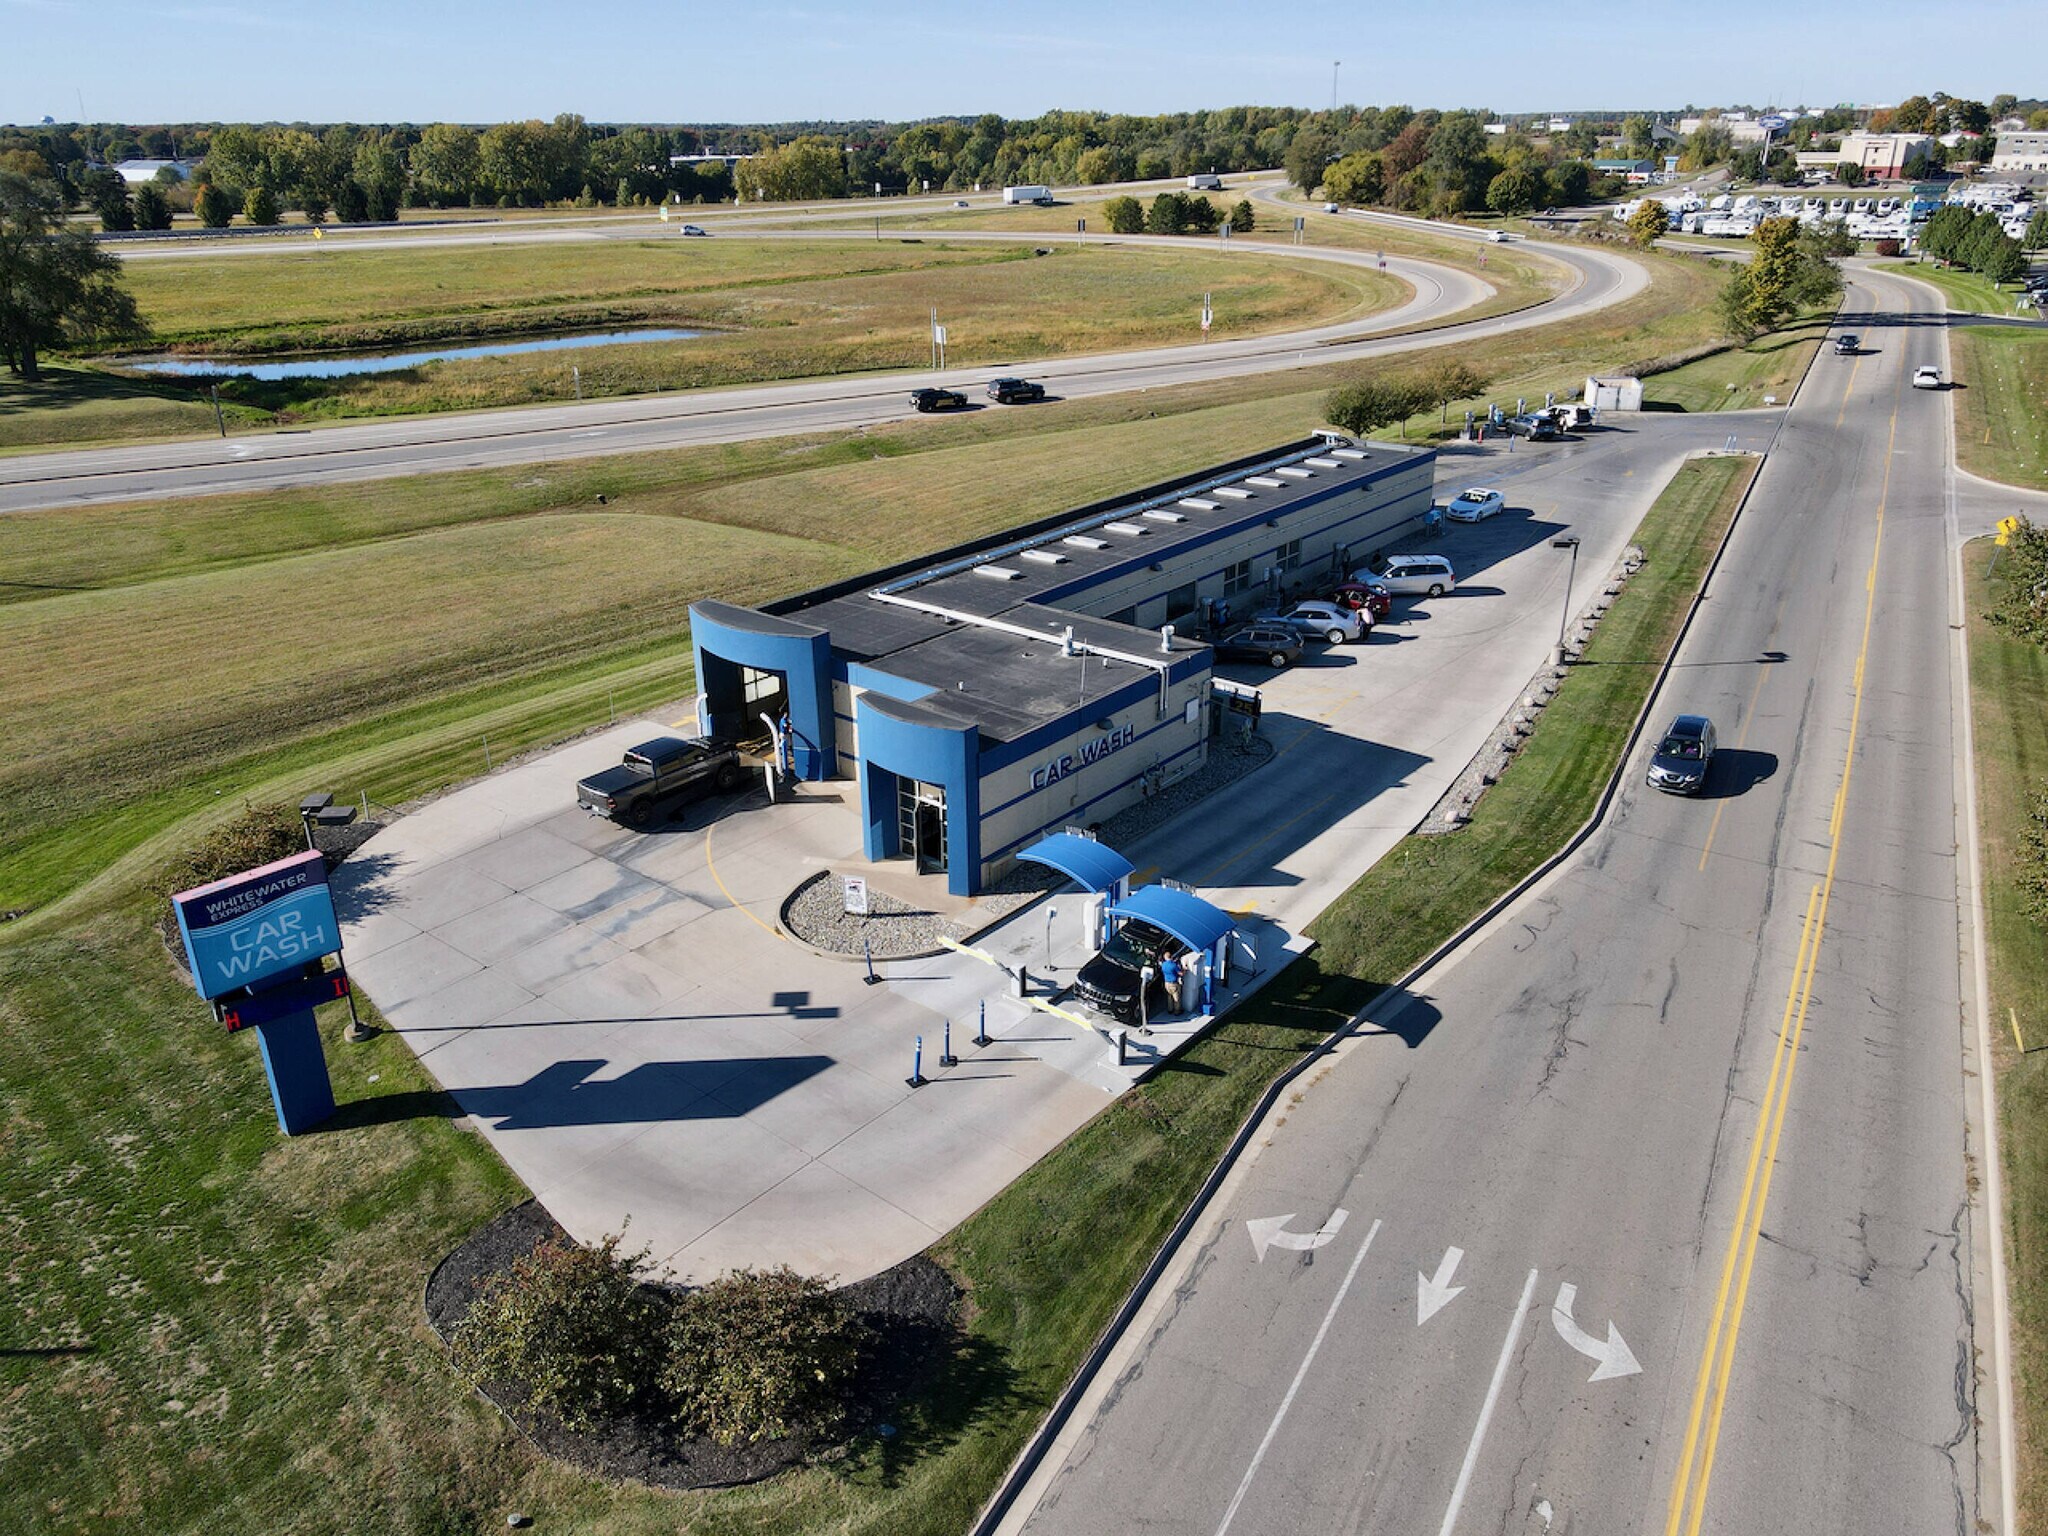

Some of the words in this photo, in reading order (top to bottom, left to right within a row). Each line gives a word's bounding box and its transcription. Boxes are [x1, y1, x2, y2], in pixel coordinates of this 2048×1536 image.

[1030, 754, 1073, 789] CAR
[1079, 722, 1134, 765] WASH
[206, 873, 307, 914] WHITEWATER
[210, 900, 264, 922] EXPRESS
[217, 924, 325, 978] WASH
[229, 910, 302, 951] CAR
